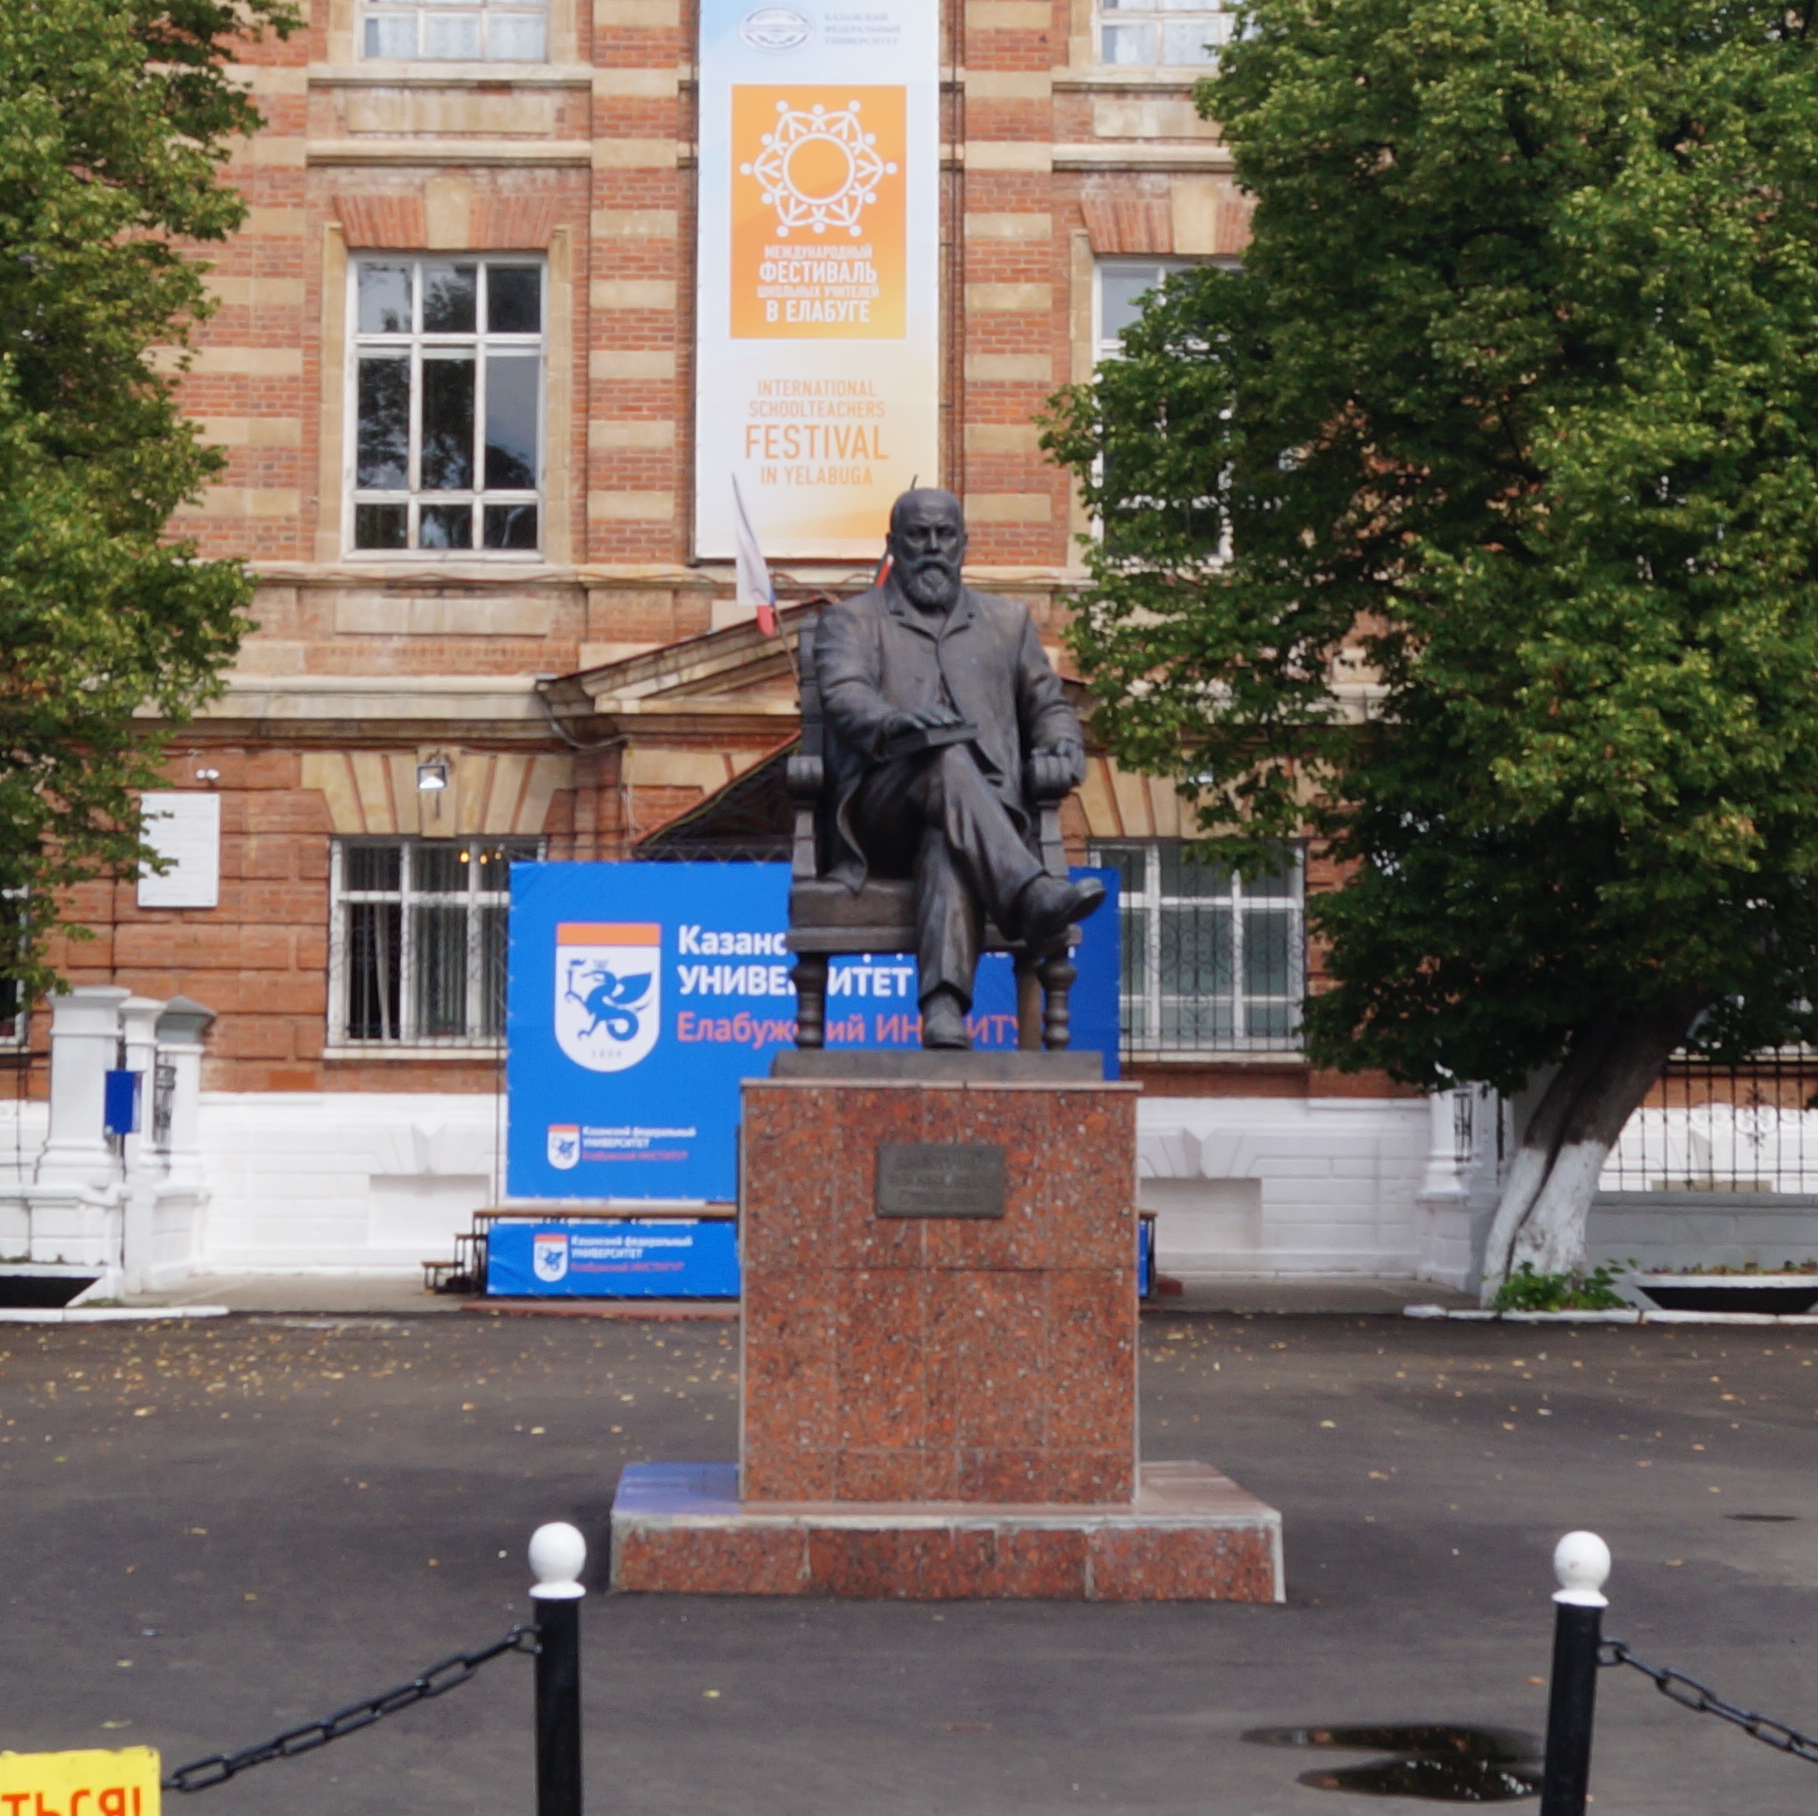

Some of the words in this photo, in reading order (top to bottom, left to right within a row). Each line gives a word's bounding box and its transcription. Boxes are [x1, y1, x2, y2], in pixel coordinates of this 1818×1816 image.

[764, 242, 873, 259] МЕЖДУНАРОДНЫЙ
[759, 260, 879, 284] ФЕСТИВАЛЬ
[757, 285, 821, 298] ШКОЛЬНЫХ
[825, 284, 881, 298] УЧИТЕЛЕЙ
[765, 299, 779, 323] В
[785, 299, 872, 323] ЕЛАБУГЕ
[757, 379, 877, 397] INTERNATIONAL
[748, 400, 886, 418] SCHOOLTEACHERS
[745, 423, 890, 460] FESTIVAL
[760, 465, 778, 485] IN
[783, 465, 874, 485] YELABUGA
[678, 924, 789, 956] Казанс
[676, 965, 914, 997] УНИВЕИТЕТ
[677, 1010, 866, 1050] Елабужий
[875, 1013, 1020, 1045] ИНИТУ
